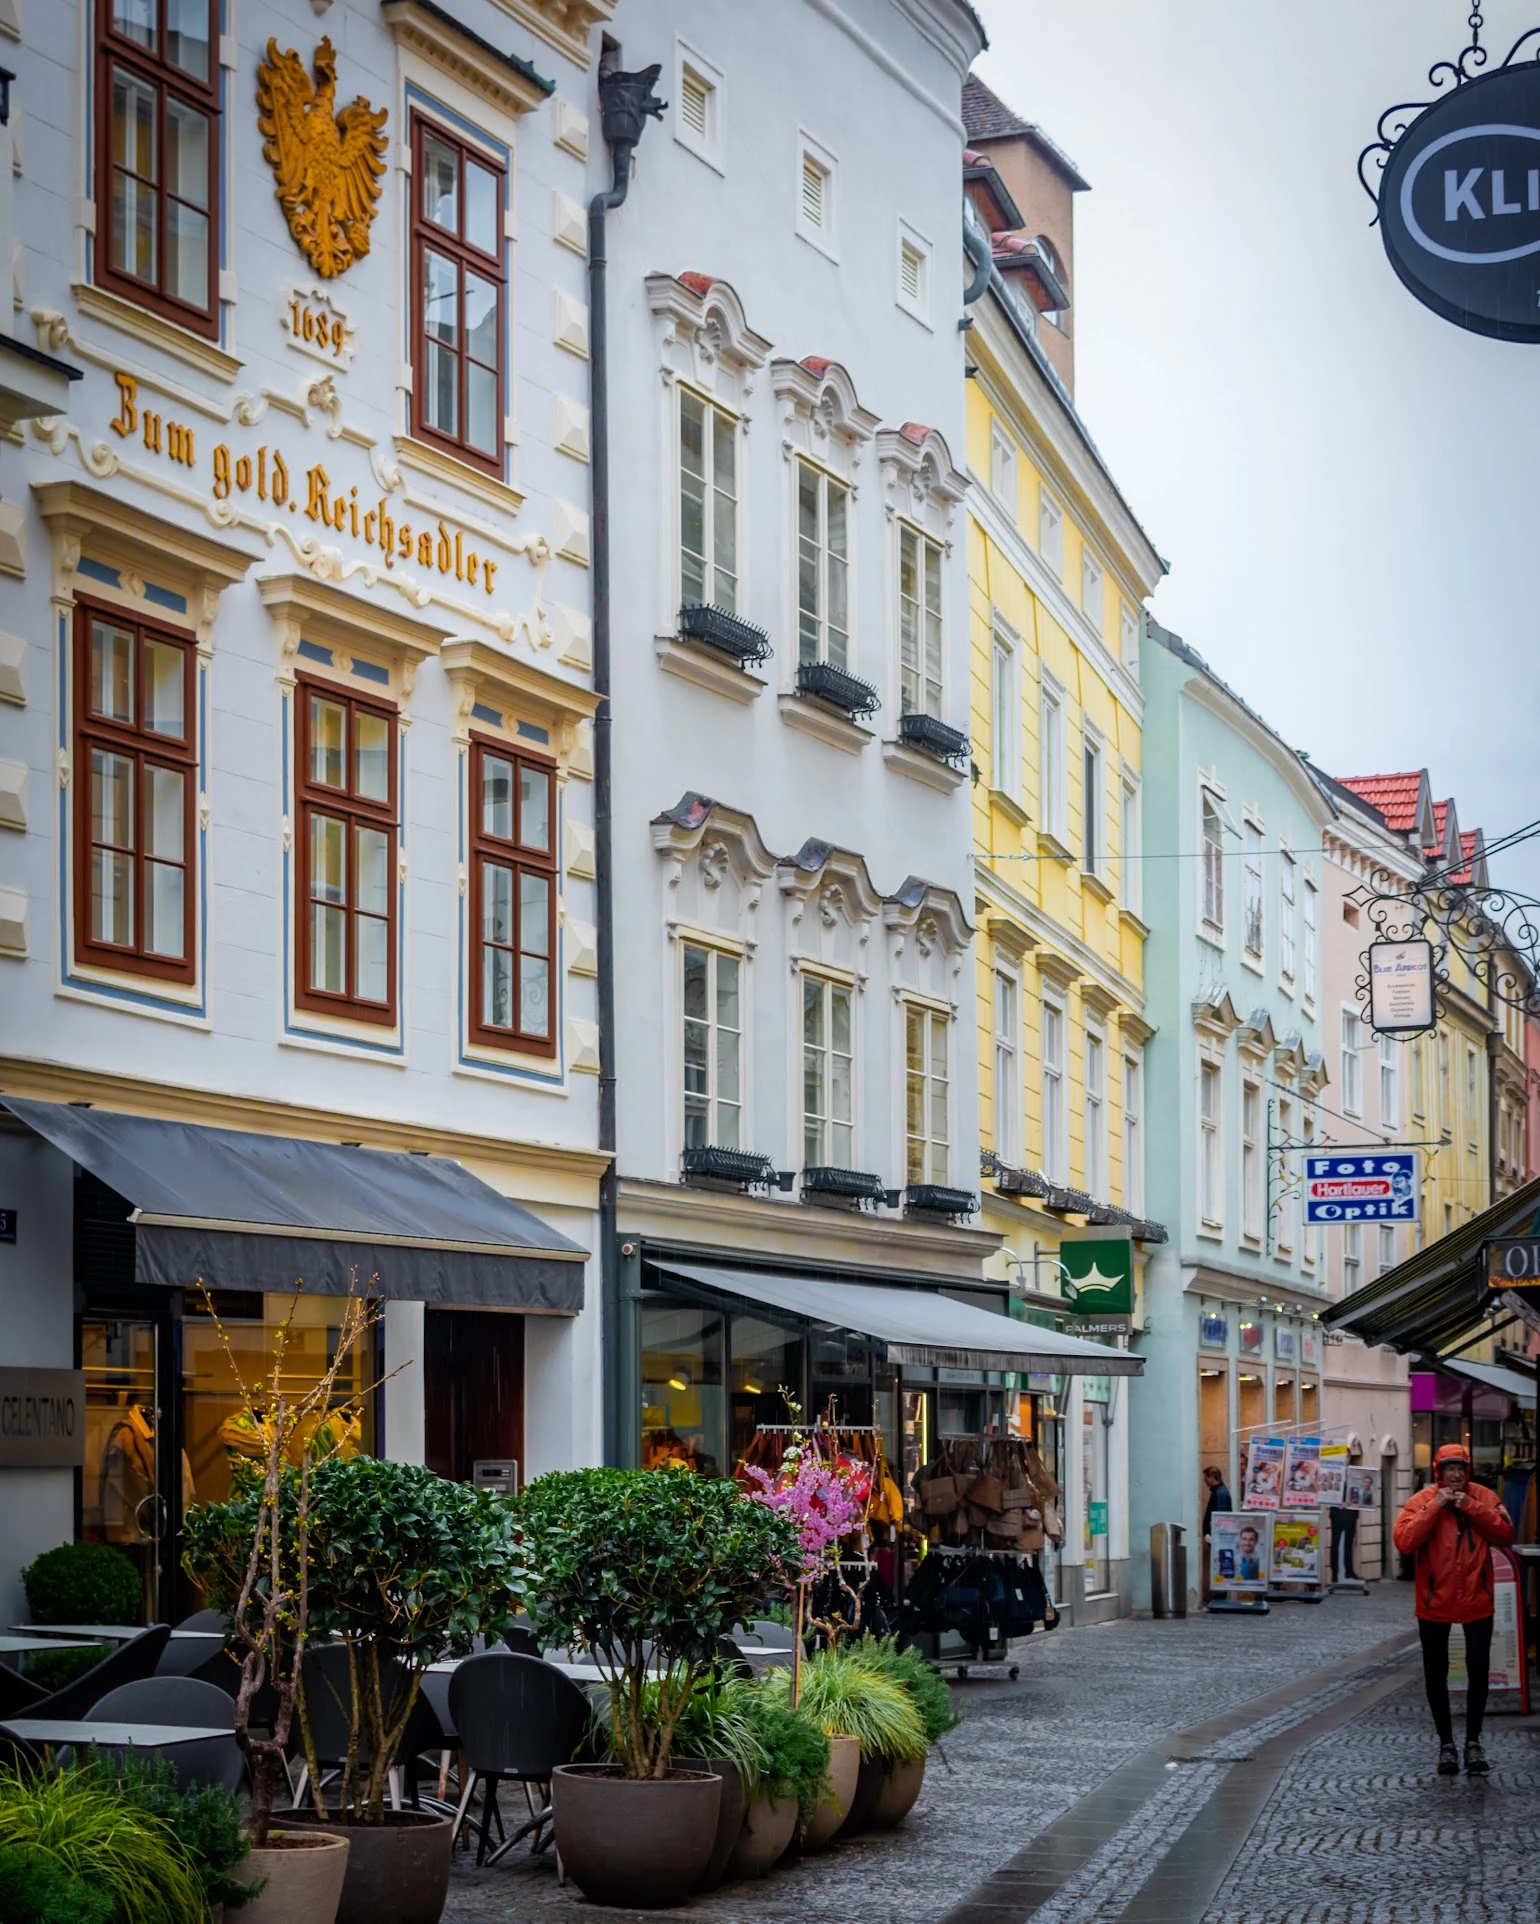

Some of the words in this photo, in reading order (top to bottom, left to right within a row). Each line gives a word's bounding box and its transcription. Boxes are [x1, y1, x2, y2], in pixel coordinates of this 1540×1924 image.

[1444, 167, 1540, 222] KLI
[292, 301, 346, 357] 1689
[1314, 1160, 1400, 1176] Foto
[1317, 1182, 1386, 1197] Hartlauer
[1314, 1202, 1409, 1220] Optik
[1065, 1324, 1127, 1333] PALMERS
[2, 1396, 75, 1437] CELENTANO
